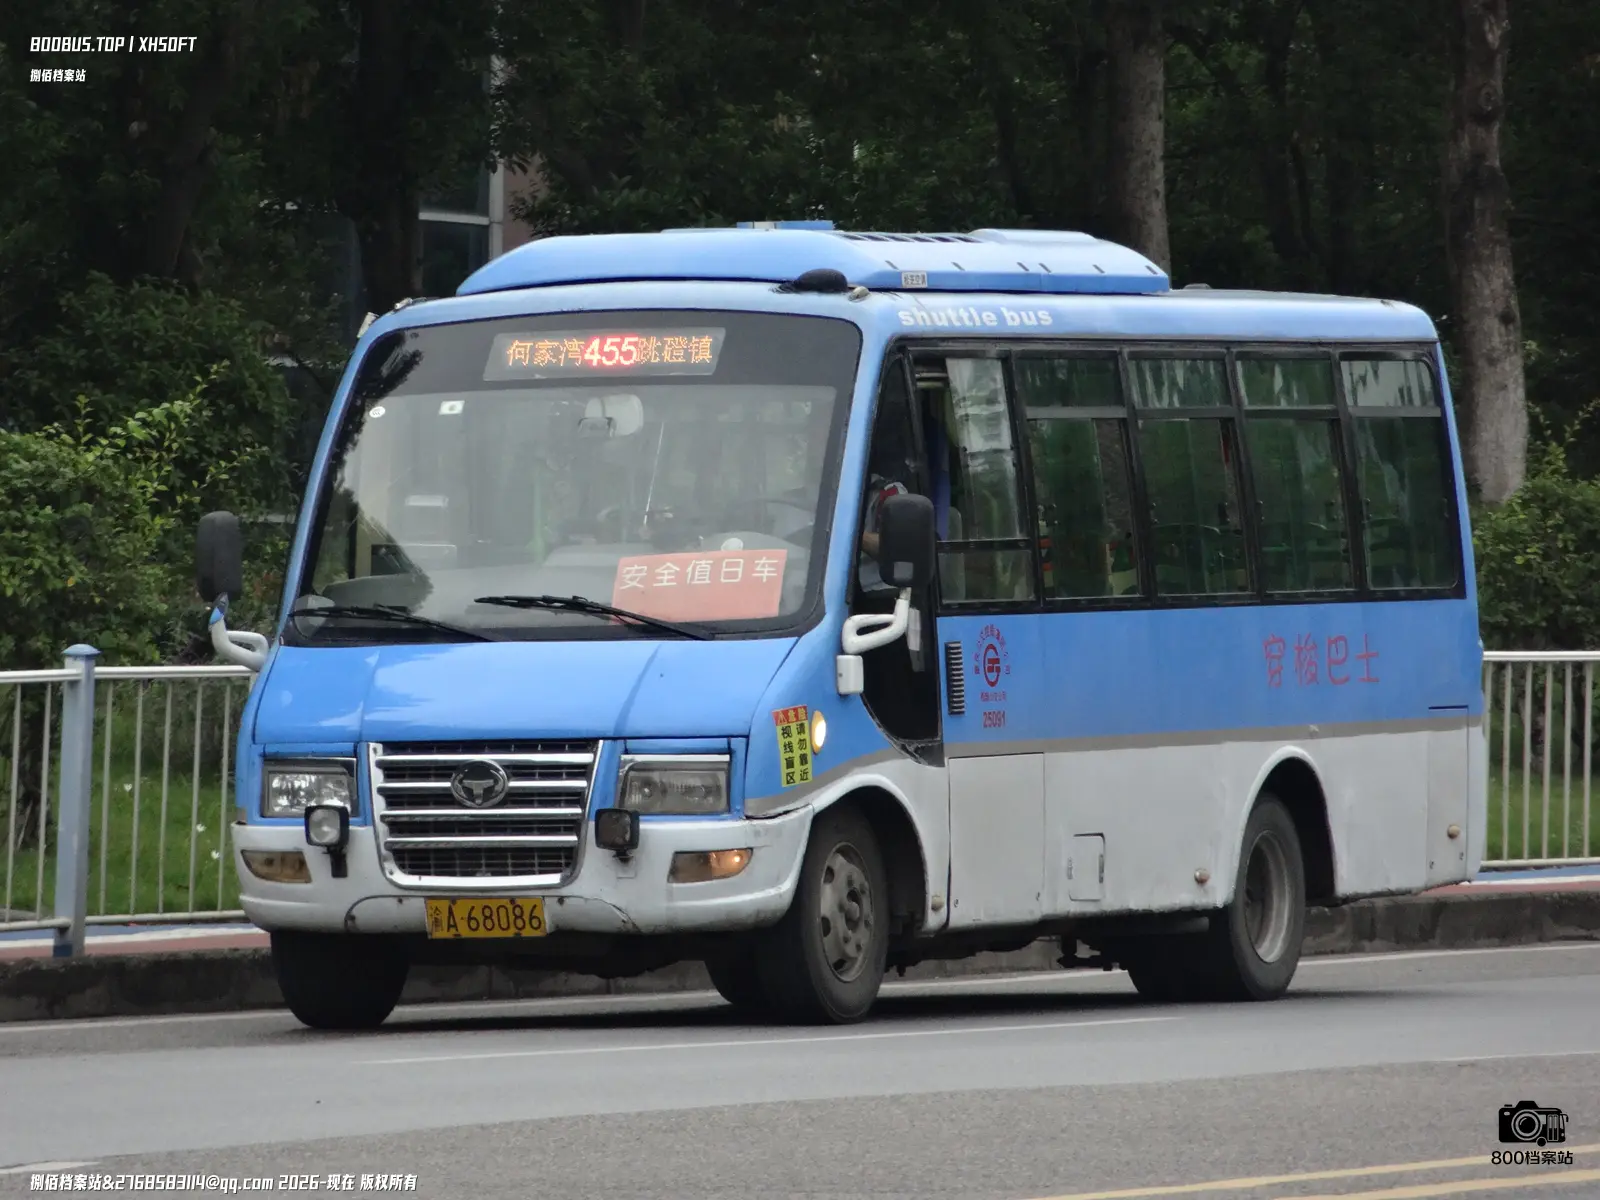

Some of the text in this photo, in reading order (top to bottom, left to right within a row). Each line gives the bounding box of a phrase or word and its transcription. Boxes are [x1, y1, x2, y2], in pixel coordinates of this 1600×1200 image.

[898, 307, 1053, 327] shuttle bus
[619, 556, 779, 590] 安全值日车
[1263, 632, 1380, 688] 穿梭巴士
[781, 725, 796, 785] 视线盲区
[796, 722, 810, 781] 请勿靠近
